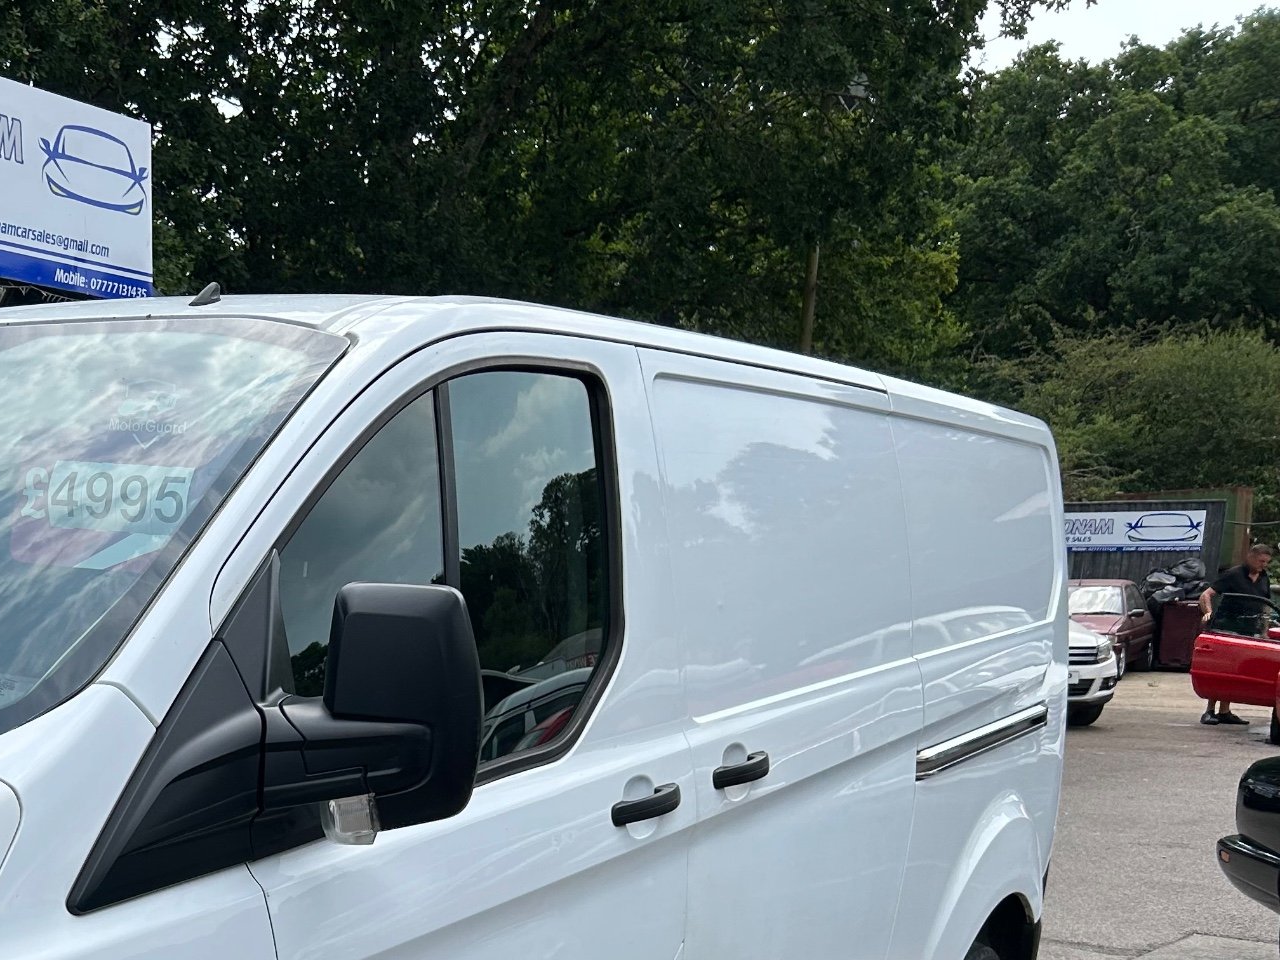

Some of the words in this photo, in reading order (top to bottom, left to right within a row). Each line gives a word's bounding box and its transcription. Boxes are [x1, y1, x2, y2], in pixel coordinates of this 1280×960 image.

[54, 268, 88, 289] Mobile:
[90, 277, 148, 298] 07777131435
[108, 417, 188, 434] MotorGuard
